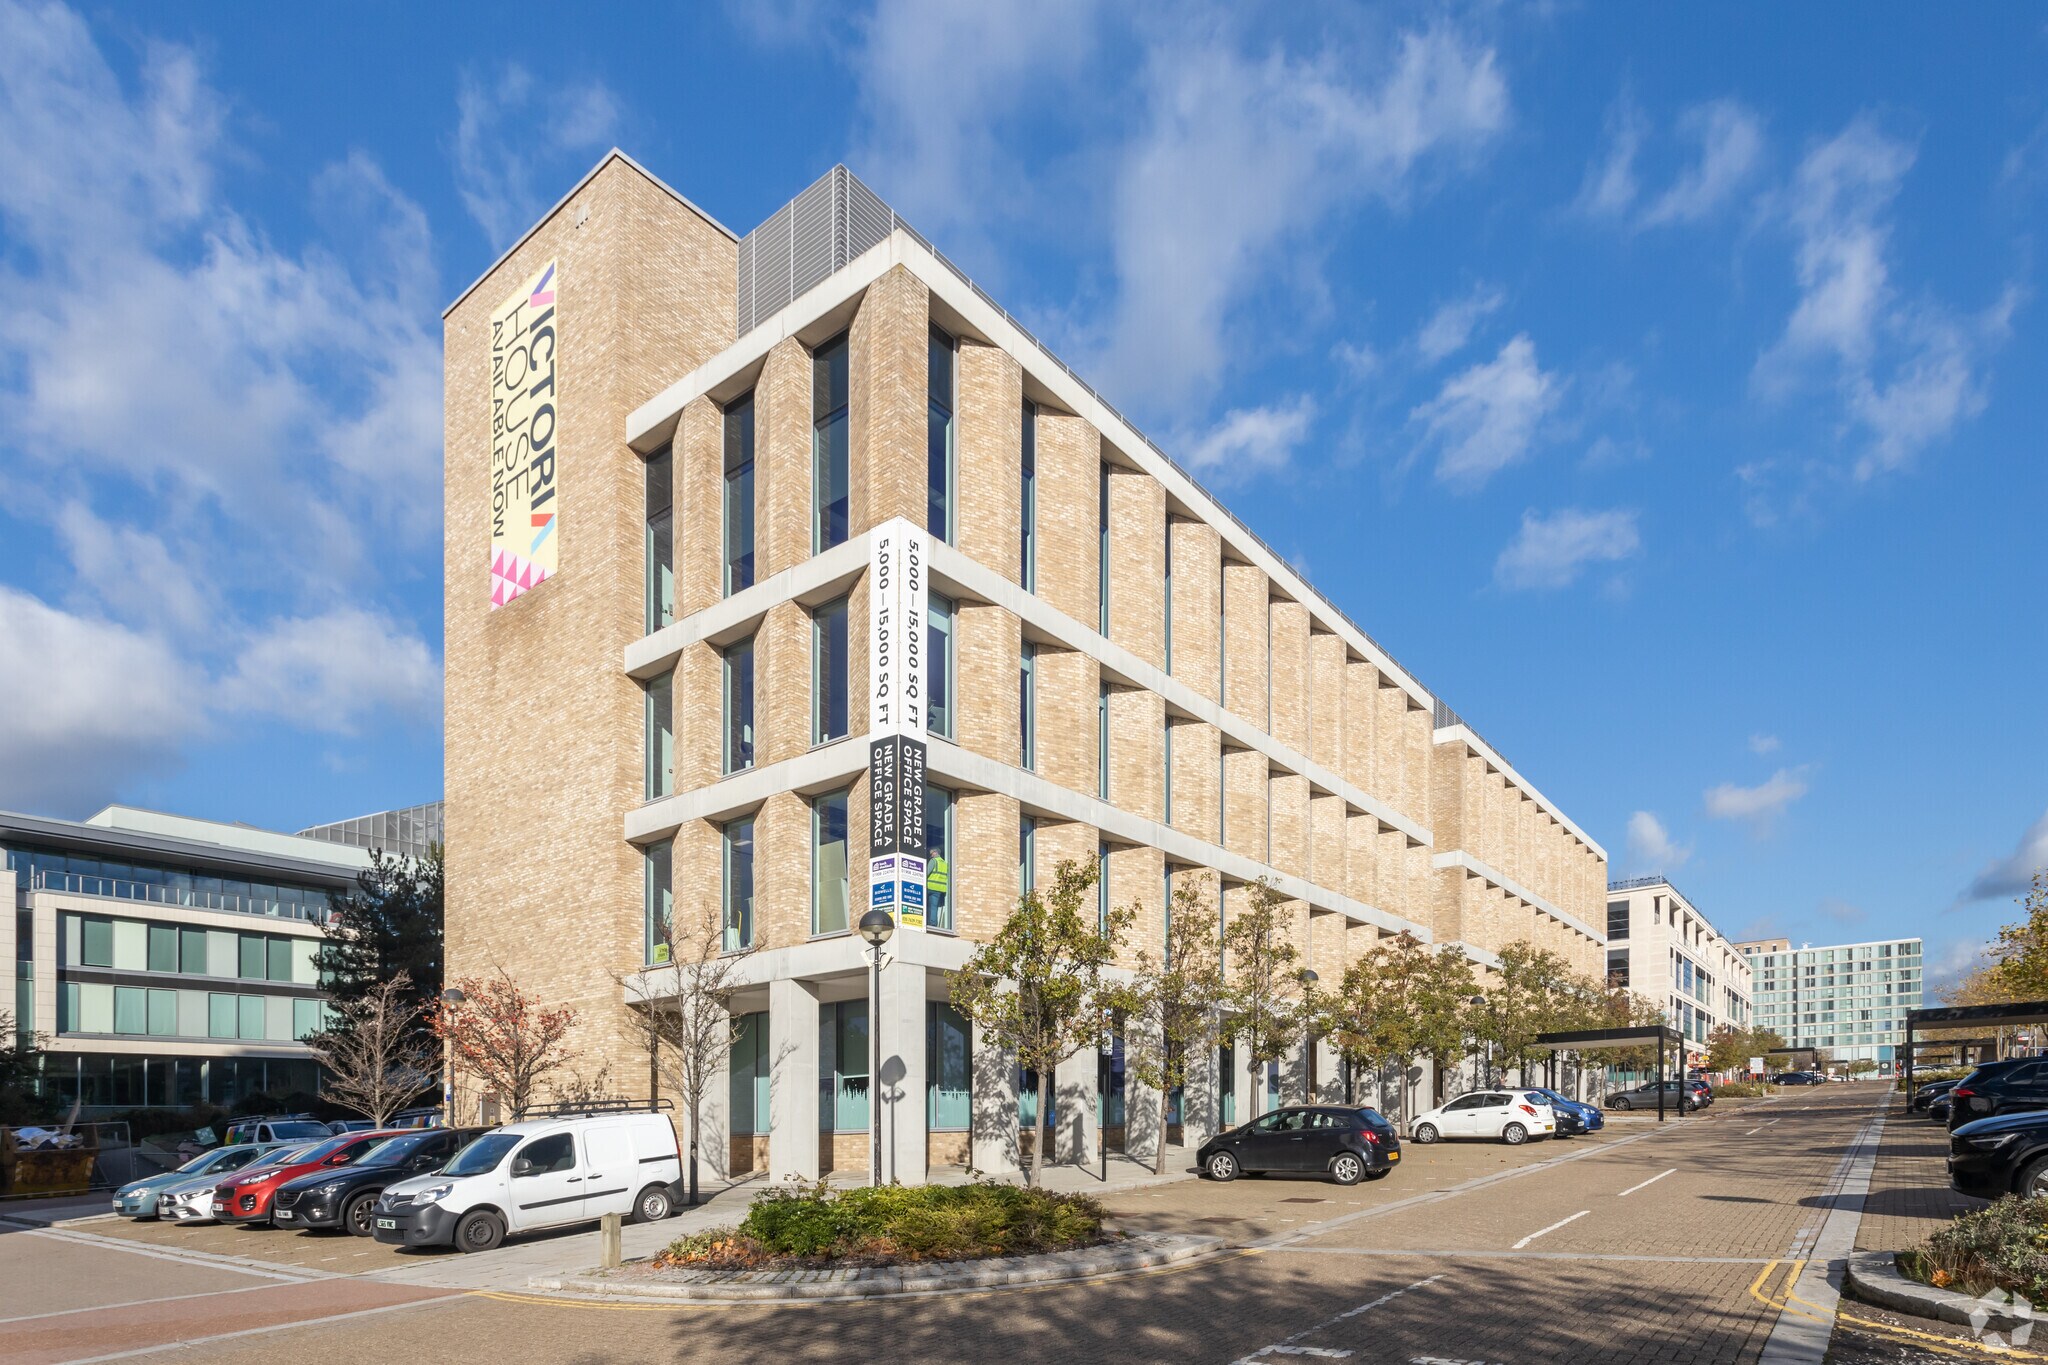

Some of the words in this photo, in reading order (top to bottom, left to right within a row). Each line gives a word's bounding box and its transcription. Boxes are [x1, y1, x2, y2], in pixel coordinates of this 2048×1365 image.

[492, 320, 504, 469] AVAILABLE
[505, 299, 529, 509] HOUSE
[492, 471, 504, 537] NOW
[876, 672, 889, 699] SQ
[906, 672, 918, 699] SQ
[878, 703, 889, 725] FT
[908, 703, 918, 728] FT
[874, 747, 882, 799] OFFICE
[884, 744, 893, 777] NEW
[904, 745, 912, 798] OFFICE
[914, 748, 922, 782] NEW
[874, 802, 882, 847] SPACE
[884, 781, 893, 832] GRADE
[904, 799, 912, 845] SPACE
[914, 785, 922, 835] GRADE
[884, 836, 893, 847] A
[914, 838, 922, 848] A
